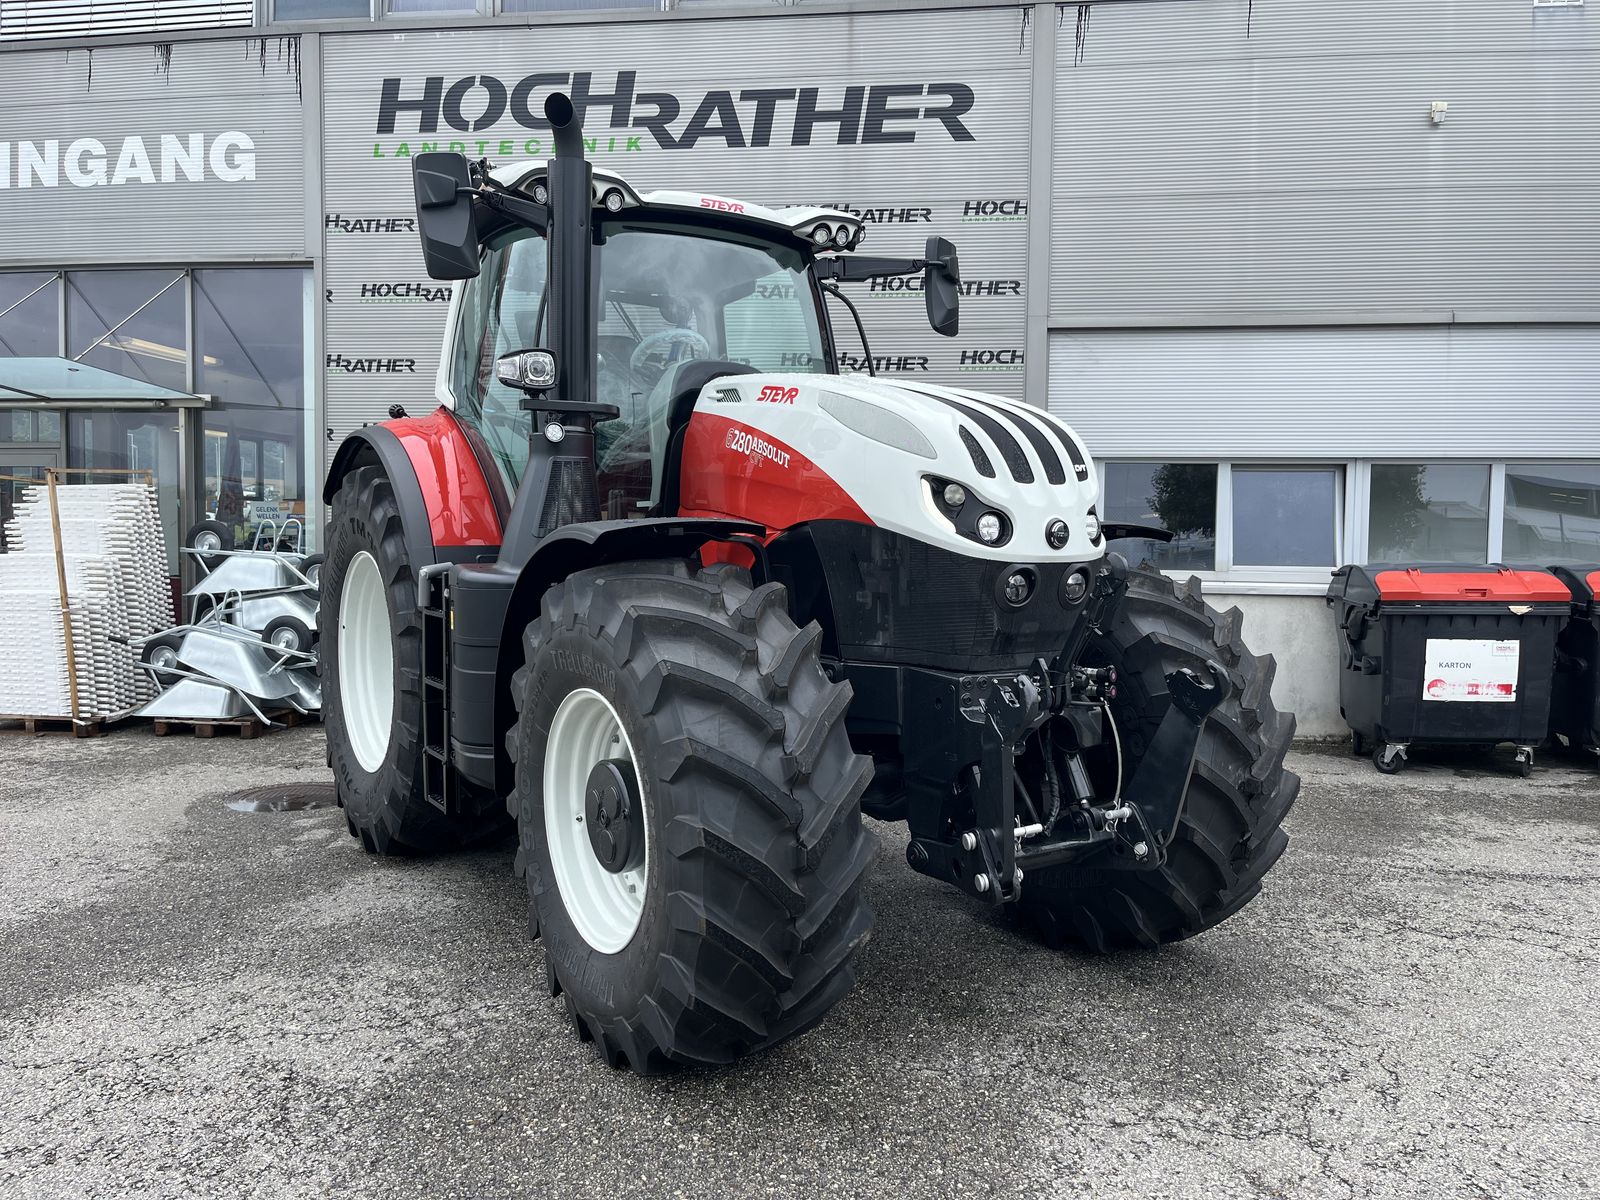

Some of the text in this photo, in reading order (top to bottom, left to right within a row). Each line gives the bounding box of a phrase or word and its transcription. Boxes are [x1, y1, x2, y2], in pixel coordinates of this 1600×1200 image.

[376, 70, 976, 150] HOCHRATHER
[0, 131, 256, 189] INGANG
[373, 136, 642, 158] LANDTECNIK
[700, 198, 744, 214] STEYR
[756, 385, 799, 404] STEYR
[726, 427, 790, 468] 6280 ABSOLUT
